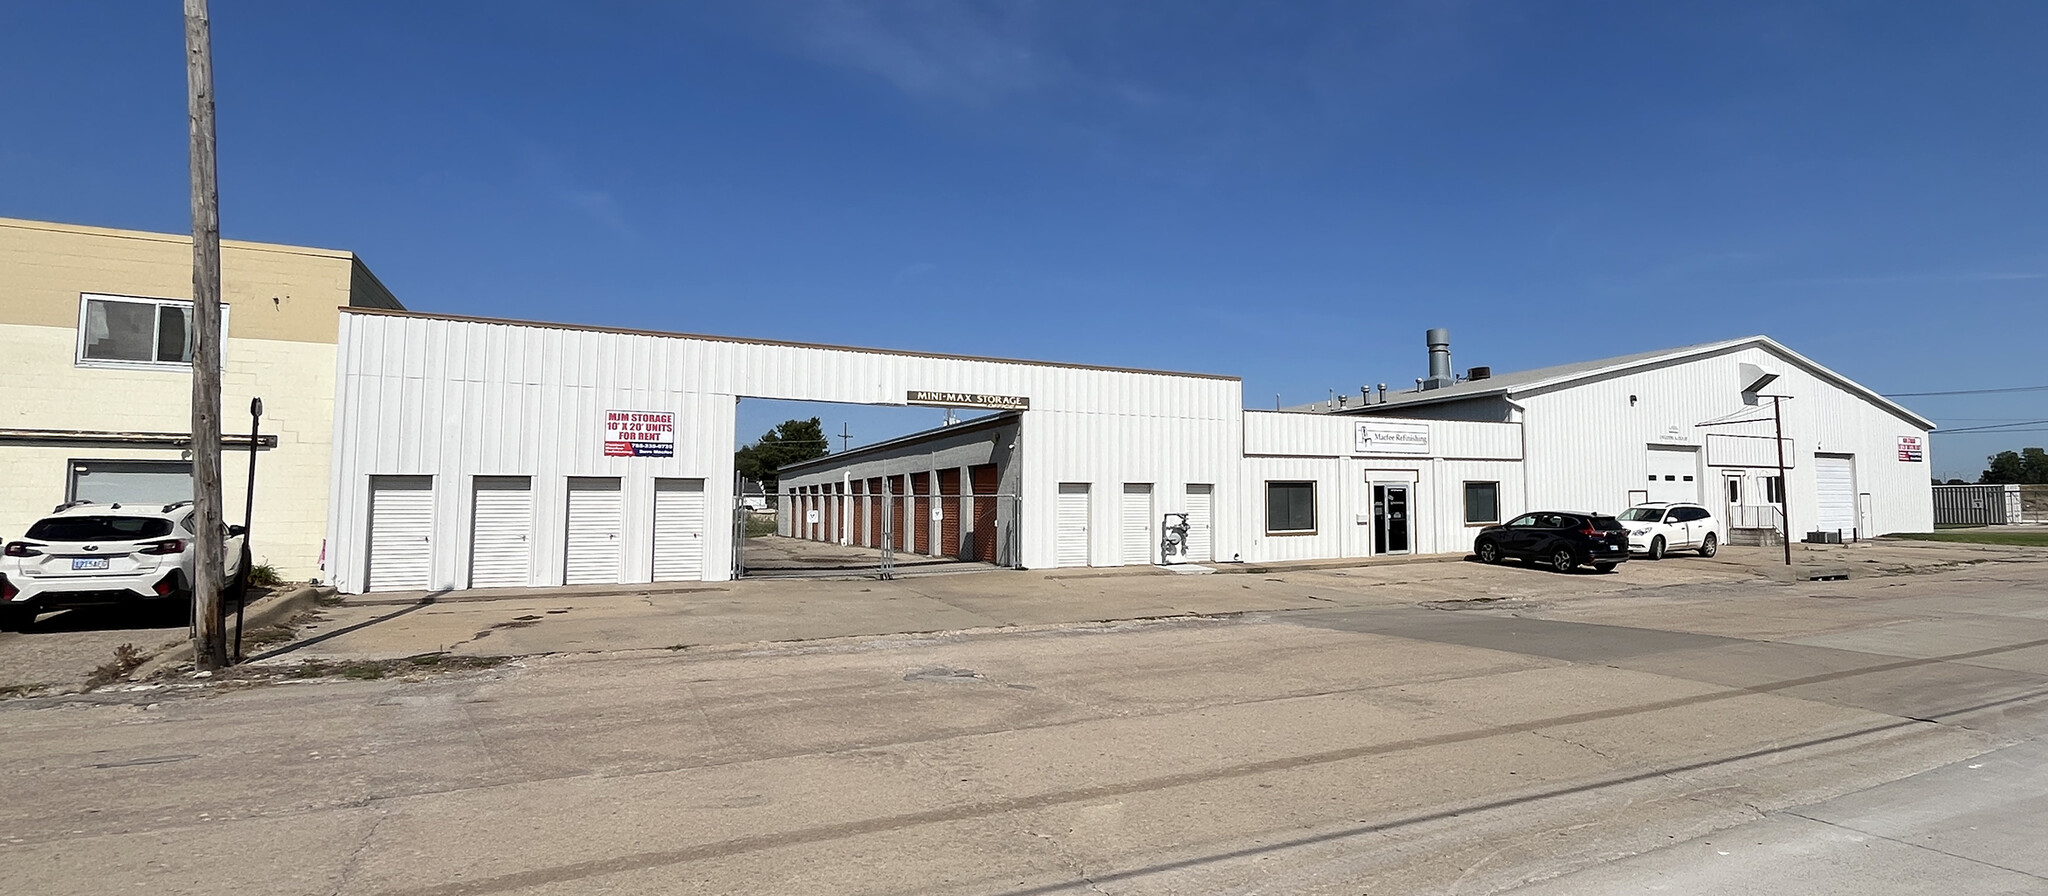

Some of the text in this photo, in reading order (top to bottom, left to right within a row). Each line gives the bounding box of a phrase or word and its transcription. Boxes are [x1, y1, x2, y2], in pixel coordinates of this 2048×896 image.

[917, 391, 1022, 405] MINI-MAX STORAGE
[608, 412, 672, 423] MJM STORAGE
[621, 422, 628, 431] X
[645, 423, 673, 432] UNITS
[618, 431, 661, 441] FOR RENT
